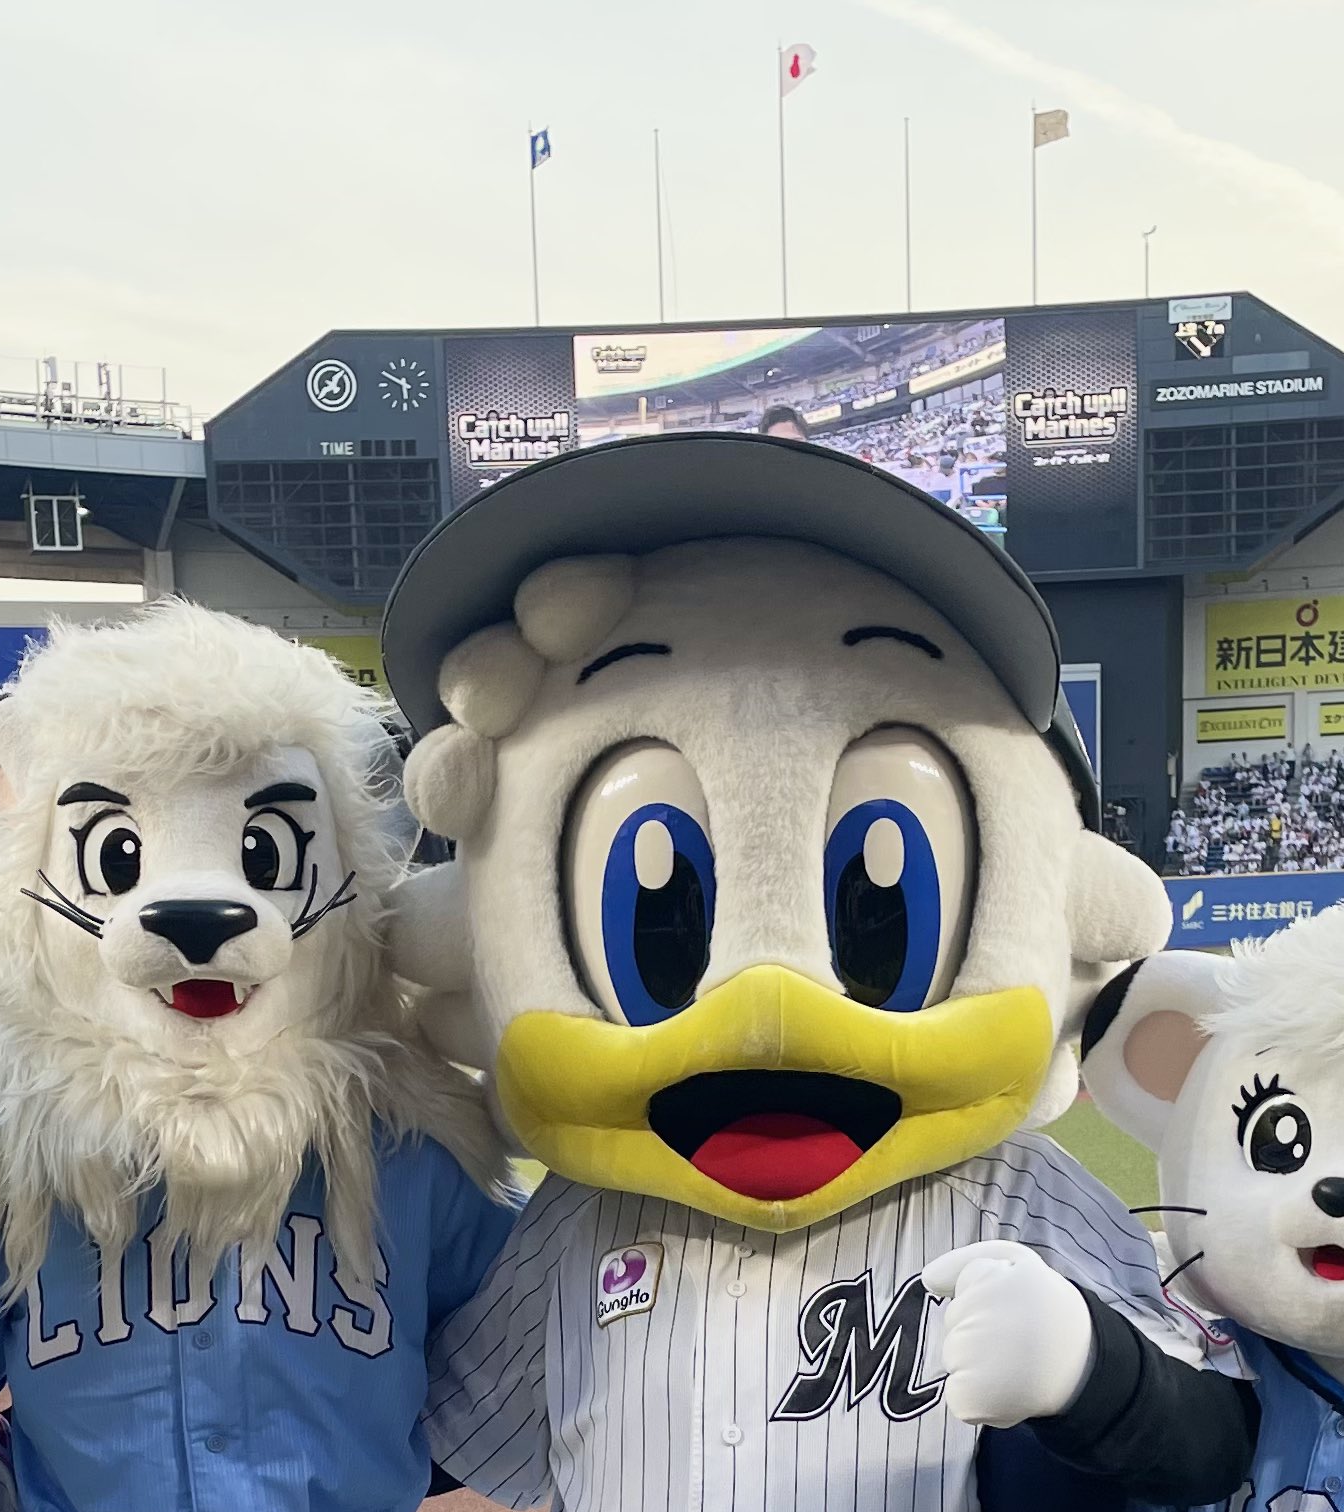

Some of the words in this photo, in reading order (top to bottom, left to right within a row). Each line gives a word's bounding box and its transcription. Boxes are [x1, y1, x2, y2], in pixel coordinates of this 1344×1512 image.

[1156, 381, 1254, 402] ZOZOMARINE
[1256, 377, 1323, 396] STADIUM
[1014, 389, 1086, 418] Catch
[458, 411, 525, 439] Catch
[1024, 414, 1116, 440] Marines
[320, 442, 354, 456] TIME
[470, 438, 559, 462] Marines
[1216, 674, 1309, 691] INTELLIGENT
[1210, 900, 1314, 922] 三井住友銀行
[27, 1211, 395, 1370] LIONS
[596, 1288, 650, 1319] GungHo
[768, 1267, 951, 1423] M
